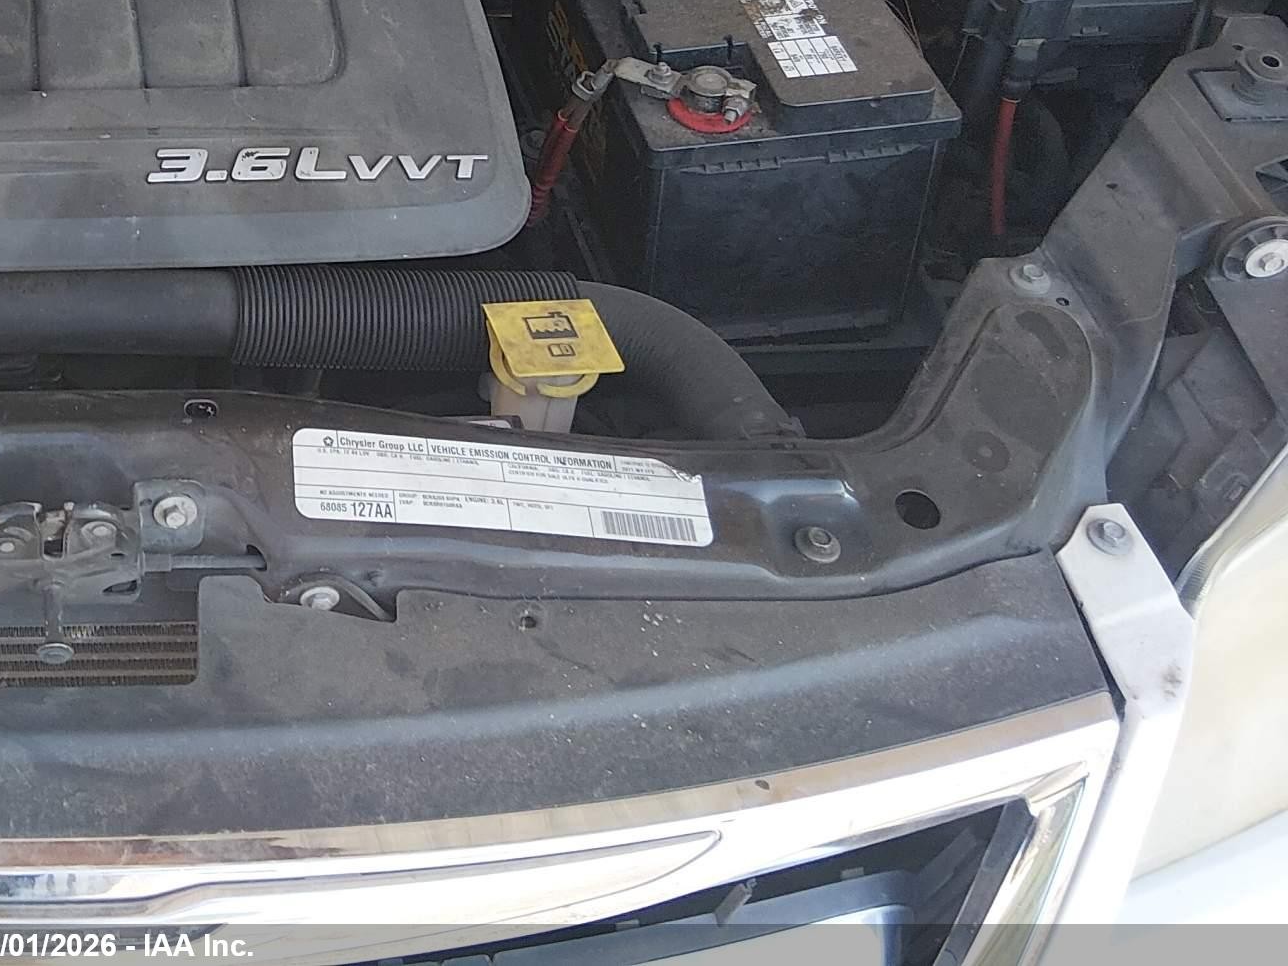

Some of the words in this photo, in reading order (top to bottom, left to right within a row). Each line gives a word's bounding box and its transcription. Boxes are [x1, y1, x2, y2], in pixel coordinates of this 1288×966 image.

[339, 437, 375, 450] Chrysler
[378, 440, 405, 452] Group
[407, 442, 424, 452] LLC
[431, 444, 466, 456] VEHICLE
[469, 448, 510, 459] EMISSION
[512, 453, 551, 465] CONTROL
[553, 456, 613, 470] INFORMATION
[320, 501, 348, 513] 68085
[350, 501, 393, 519] 127AA
